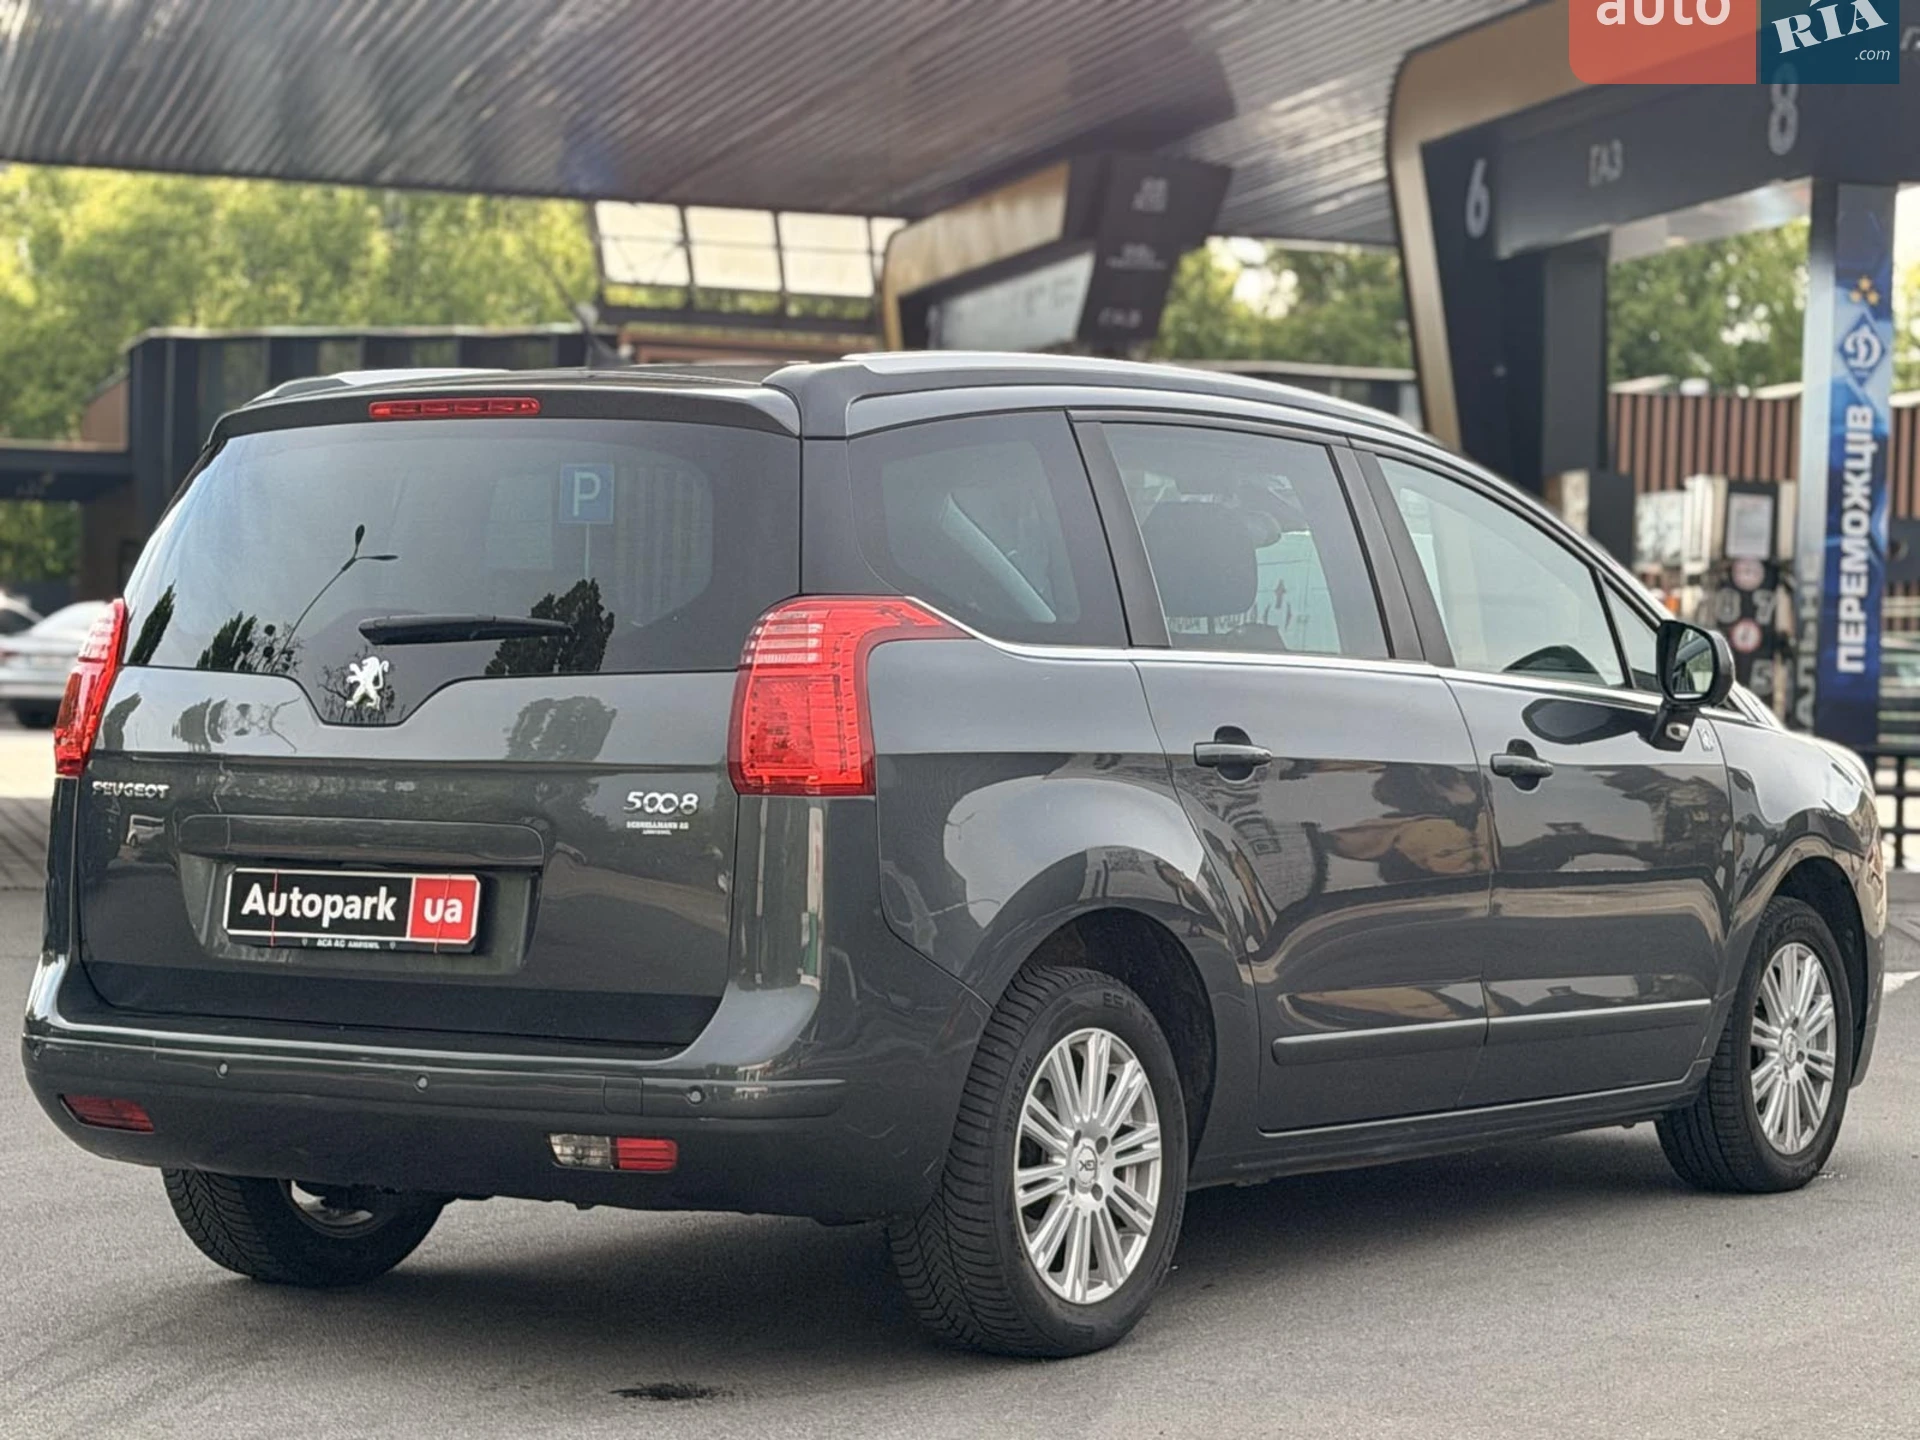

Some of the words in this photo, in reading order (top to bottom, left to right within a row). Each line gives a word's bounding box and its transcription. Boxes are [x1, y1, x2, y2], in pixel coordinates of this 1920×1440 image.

[1465, 158, 1490, 239] 6
[572, 470, 601, 517] P
[1837, 404, 1878, 674] ПЕРЕМОЖЦІВ
[92, 780, 170, 799] PEUGEOT
[623, 791, 699, 815] 5008
[241, 882, 397, 928] Autopark
[423, 896, 463, 924] ua
